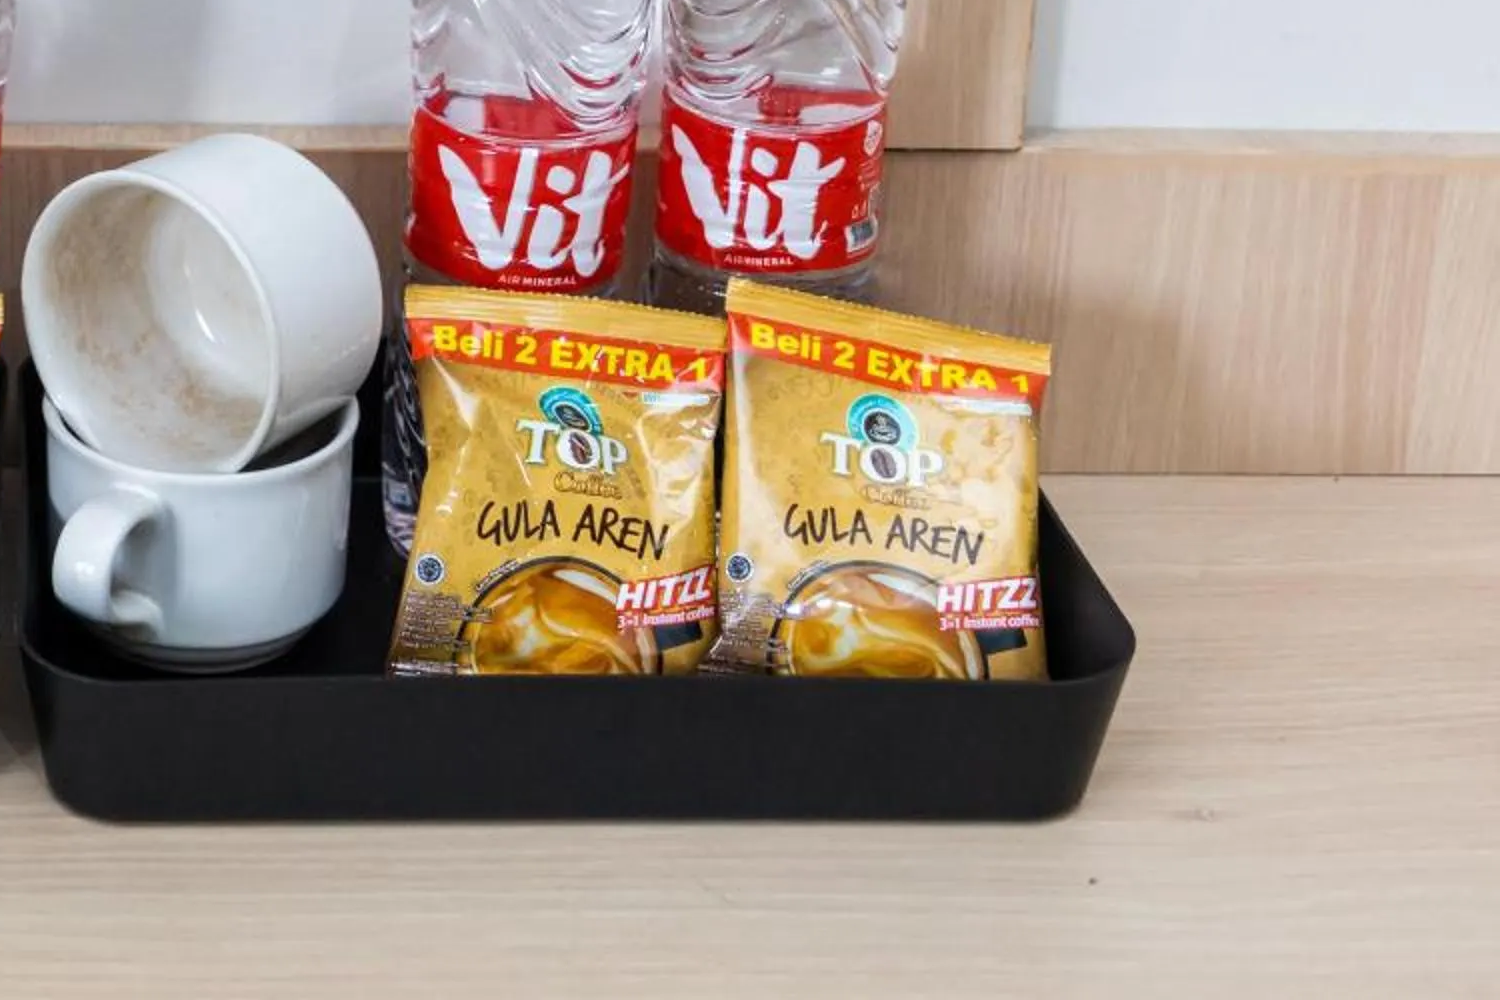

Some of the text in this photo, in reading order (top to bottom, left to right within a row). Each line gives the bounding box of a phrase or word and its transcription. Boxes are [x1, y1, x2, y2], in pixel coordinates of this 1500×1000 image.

[437, 145, 629, 277] Vit
[671, 123, 846, 260] Vit
[498, 273, 577, 287] AIR MINERAL
[432, 324, 709, 382] Beli 2 EXTRA 1
[749, 323, 1029, 393] Beli 2 EXTRA 1
[516, 419, 628, 476] TOP
[820, 431, 944, 488] TOP
[476, 499, 670, 561] GULA AREN
[783, 503, 985, 565] GULA AREN
[937, 578, 1037, 612] HITZZ
